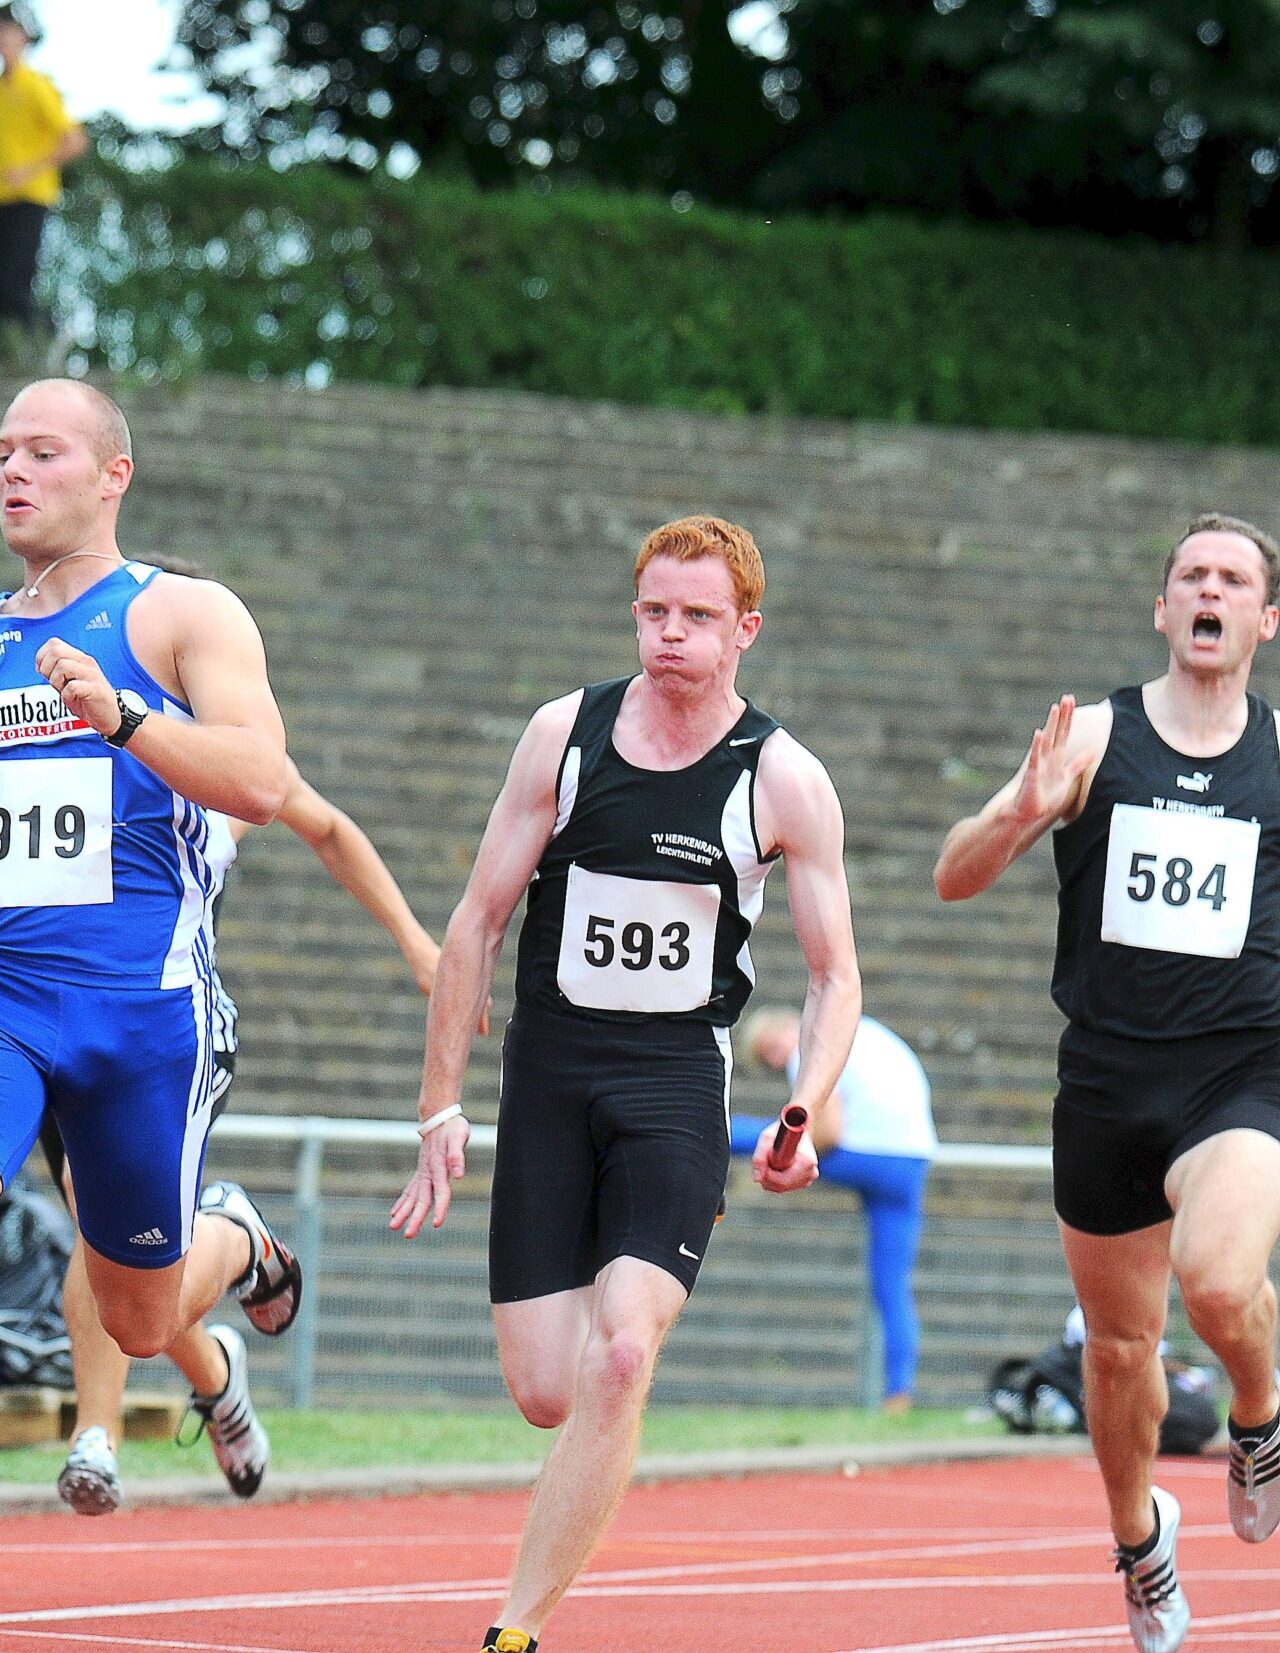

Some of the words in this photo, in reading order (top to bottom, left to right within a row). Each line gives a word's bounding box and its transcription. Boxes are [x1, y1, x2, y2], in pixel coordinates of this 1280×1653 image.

[650, 833, 664, 844] TV
[665, 832, 723, 861] HERKENRATH
[656, 845, 713, 867] LEICHTATHLETIK
[1127, 852, 1227, 911] 584
[583, 914, 690, 971] 593
[129, 1237, 168, 1246] adidas
